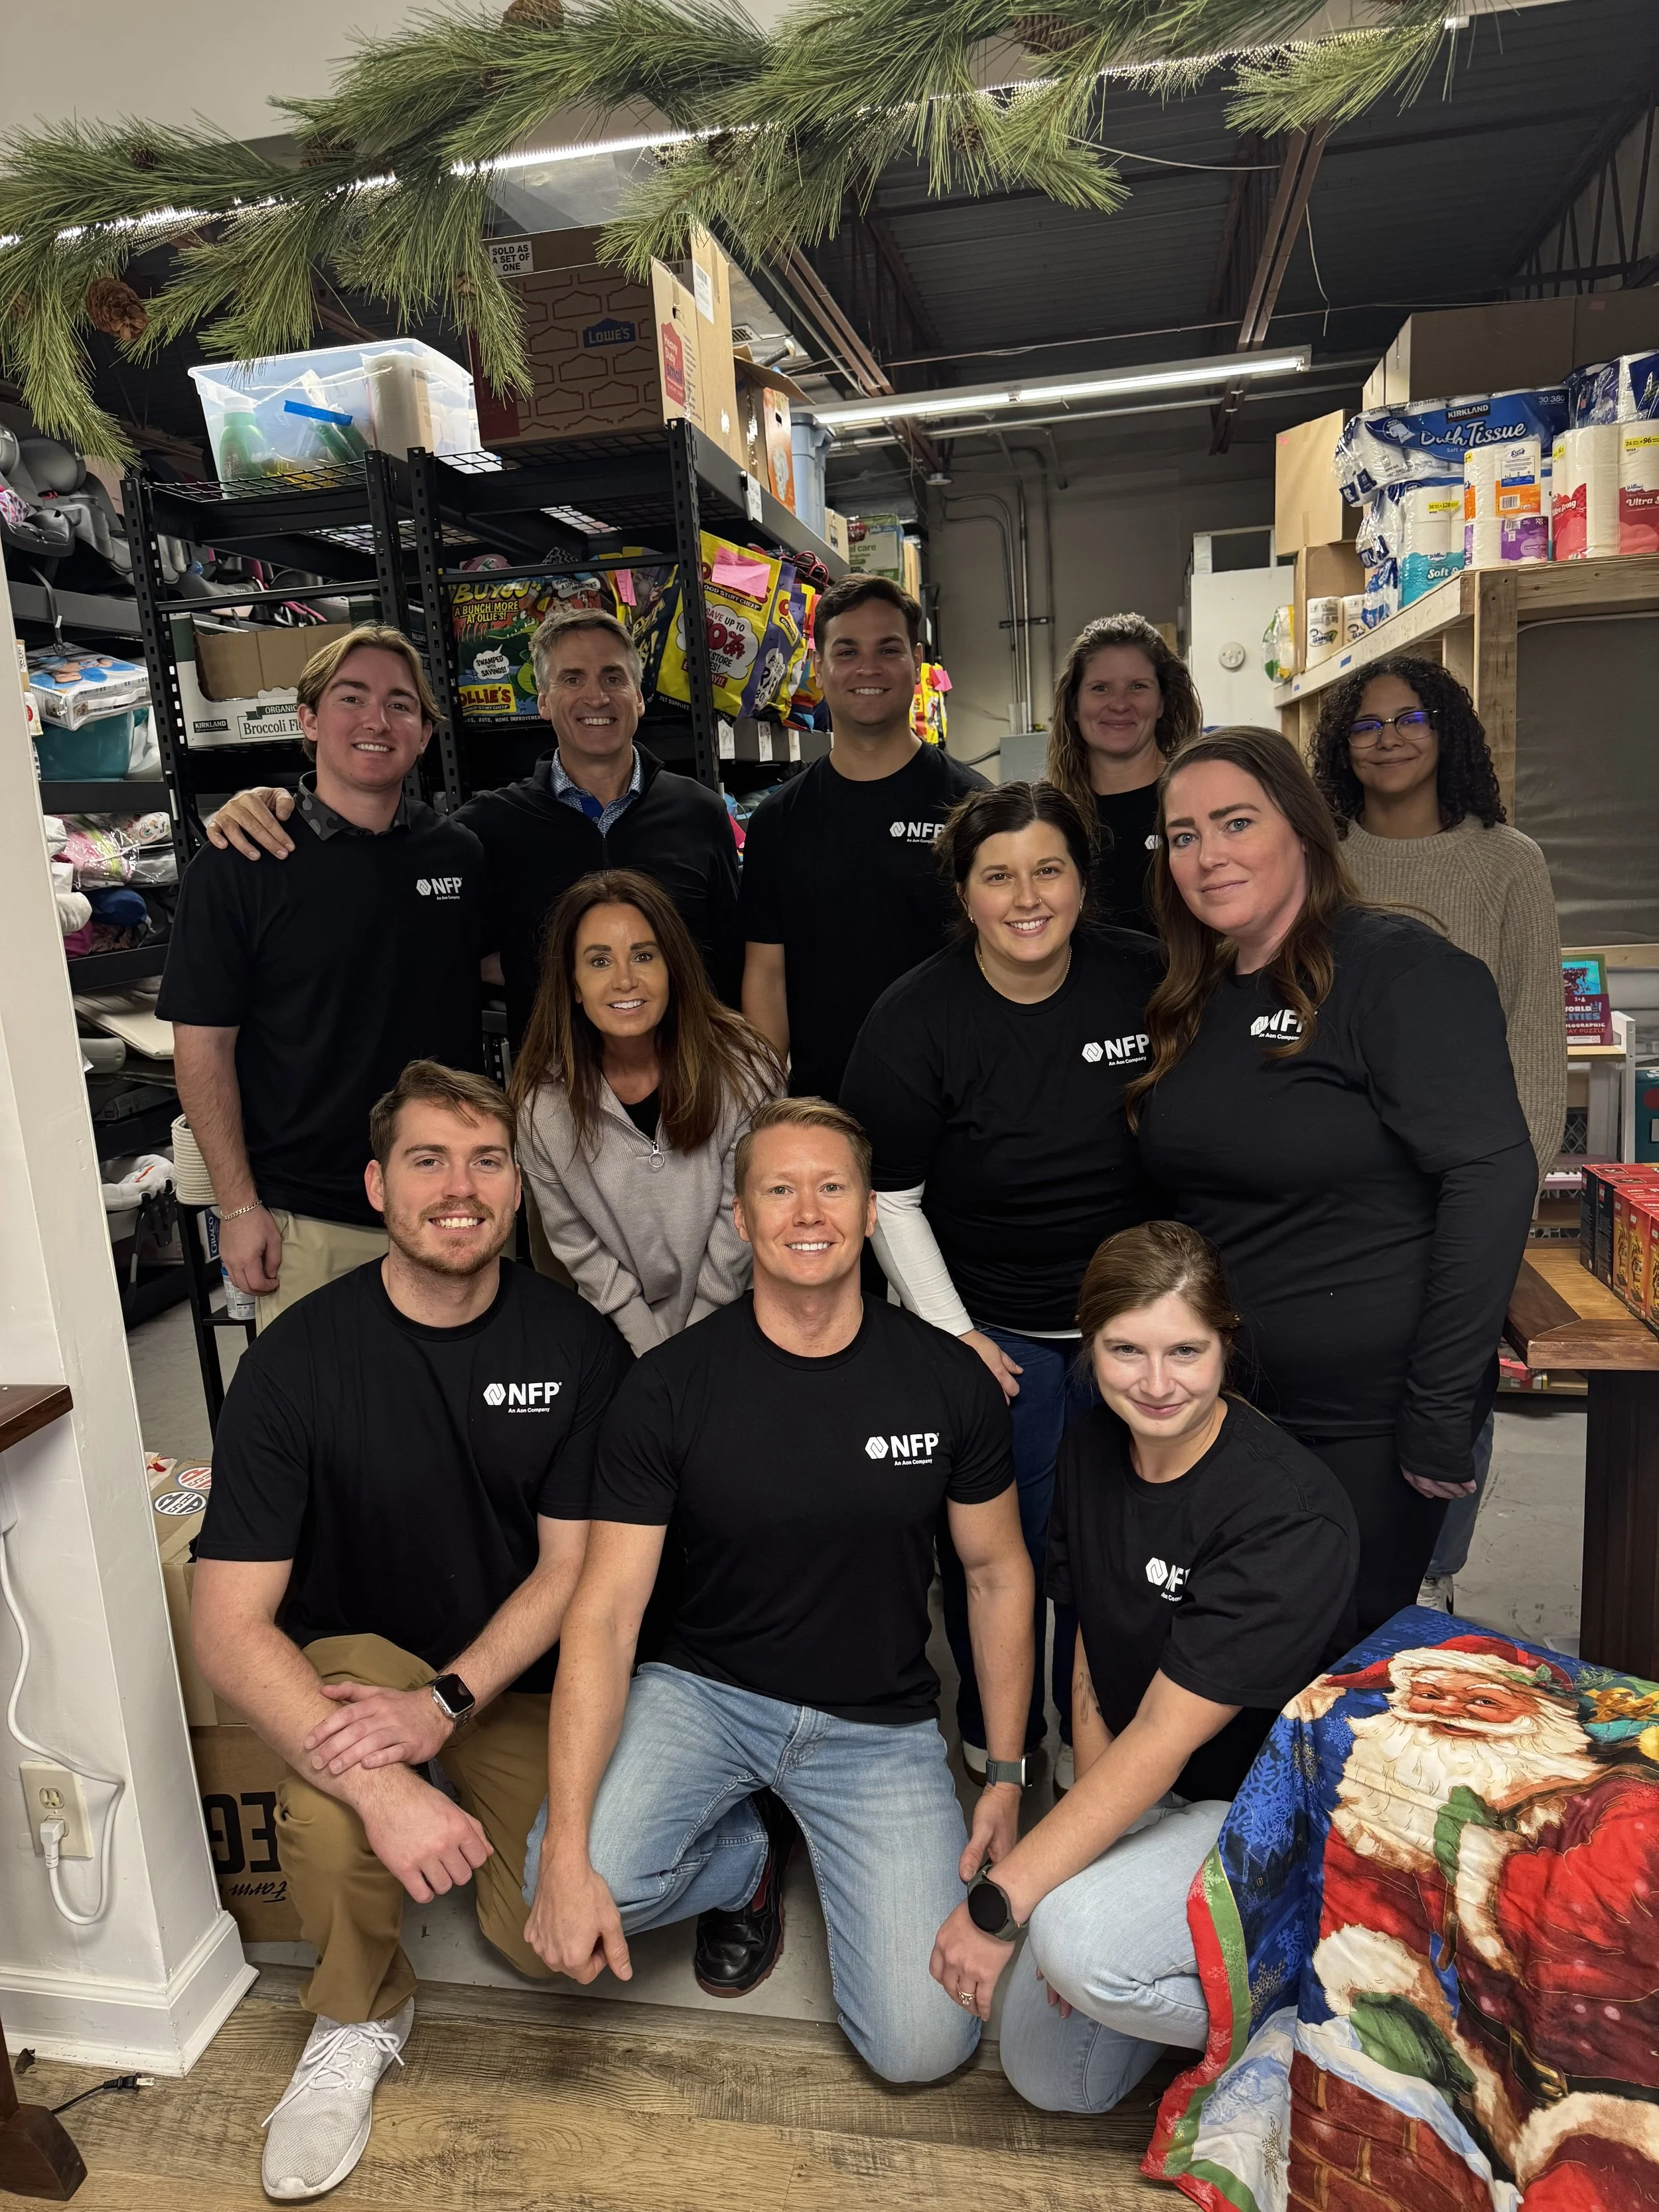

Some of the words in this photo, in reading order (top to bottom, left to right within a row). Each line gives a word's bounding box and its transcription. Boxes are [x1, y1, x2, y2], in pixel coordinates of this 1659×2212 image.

[492, 246, 514, 256] SOLD
[517, 244, 528, 253] AS
[500, 255, 516, 263] SET
[519, 253, 530, 261] OF
[502, 263, 521, 271] ONE
[589, 327, 630, 344] LOWE'S
[664, 332, 678, 355] Heavy
[665, 350, 676, 366] Duty
[666, 364, 682, 383] small
[1447, 405, 1489, 419] KIRKLAND
[1467, 421, 1526, 447] Tissue
[1626, 498, 1653, 506] Ultra
[1427, 567, 1449, 580] Soft
[703, 585, 719, 595] OOD
[739, 599, 760, 610] CHEAP
[455, 607, 460, 616] A
[462, 604, 491, 615] BUNCH
[493, 601, 519, 613] MORE
[466, 615, 476, 625] AT
[476, 611, 507, 623] OLLIE'S!
[705, 607, 724, 623] SAVE
[724, 617, 735, 627] UP
[737, 622, 745, 632] TO
[476, 655, 504, 667] SWAMPED
[711, 652, 733, 667] STORE
[480, 666, 508, 677] SAVINGS!
[265, 705, 298, 713] ORGANIC
[244, 720, 286, 735] Broccoli
[906, 822, 945, 838] NFP
[431, 877, 462, 894] NFP
[1104, 1033, 1149, 1059] NFP
[208, 1217, 218, 1254] GRACO
[508, 1382, 560, 1405] NFP
[890, 1432, 939, 1458] NFP
[231, 1880, 288, 1903] Farm
